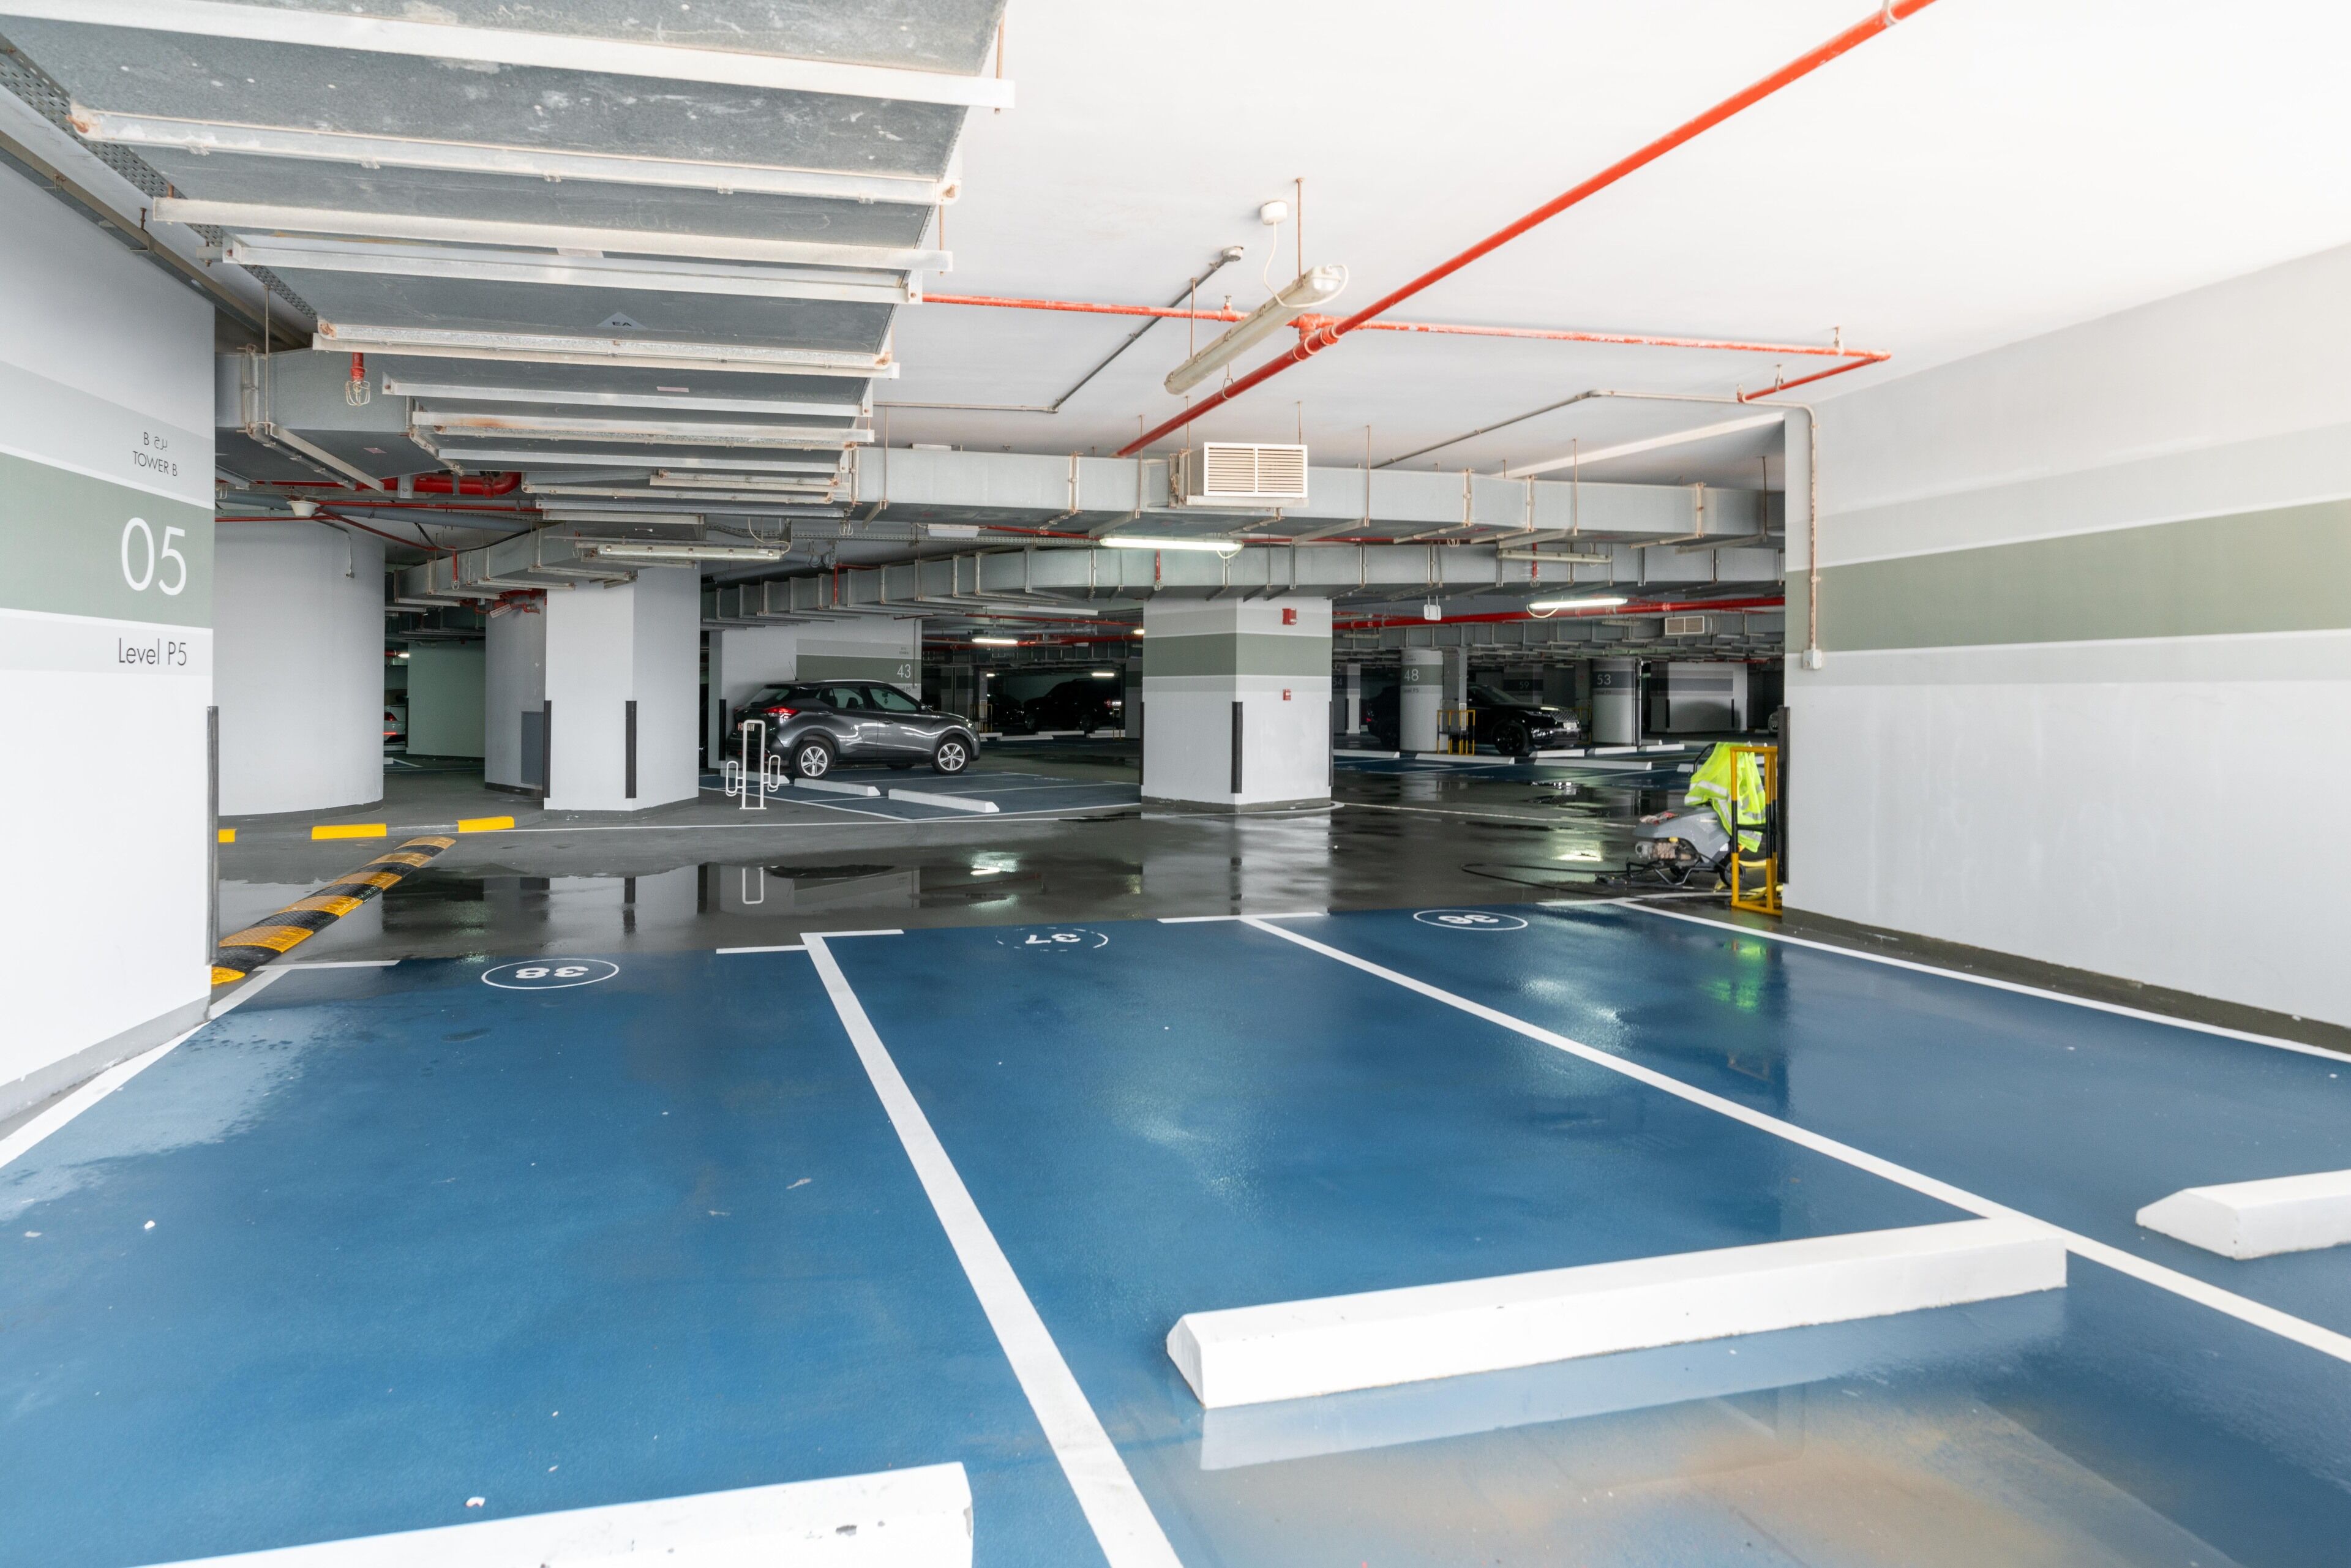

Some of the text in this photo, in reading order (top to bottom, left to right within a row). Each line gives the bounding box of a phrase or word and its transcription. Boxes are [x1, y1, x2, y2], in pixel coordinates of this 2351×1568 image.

[143, 432, 168, 452] برج B
[132, 451, 178, 476] TOWER B
[121, 517, 187, 596] 05
[119, 638, 187, 666] Level P5
[896, 664, 911, 678] 43
[1404, 669, 1419, 681] 48
[1597, 674, 1611, 685] 53
[1438, 914, 1499, 925] 36
[1025, 934, 1081, 944] 37
[515, 966, 589, 979] 38
